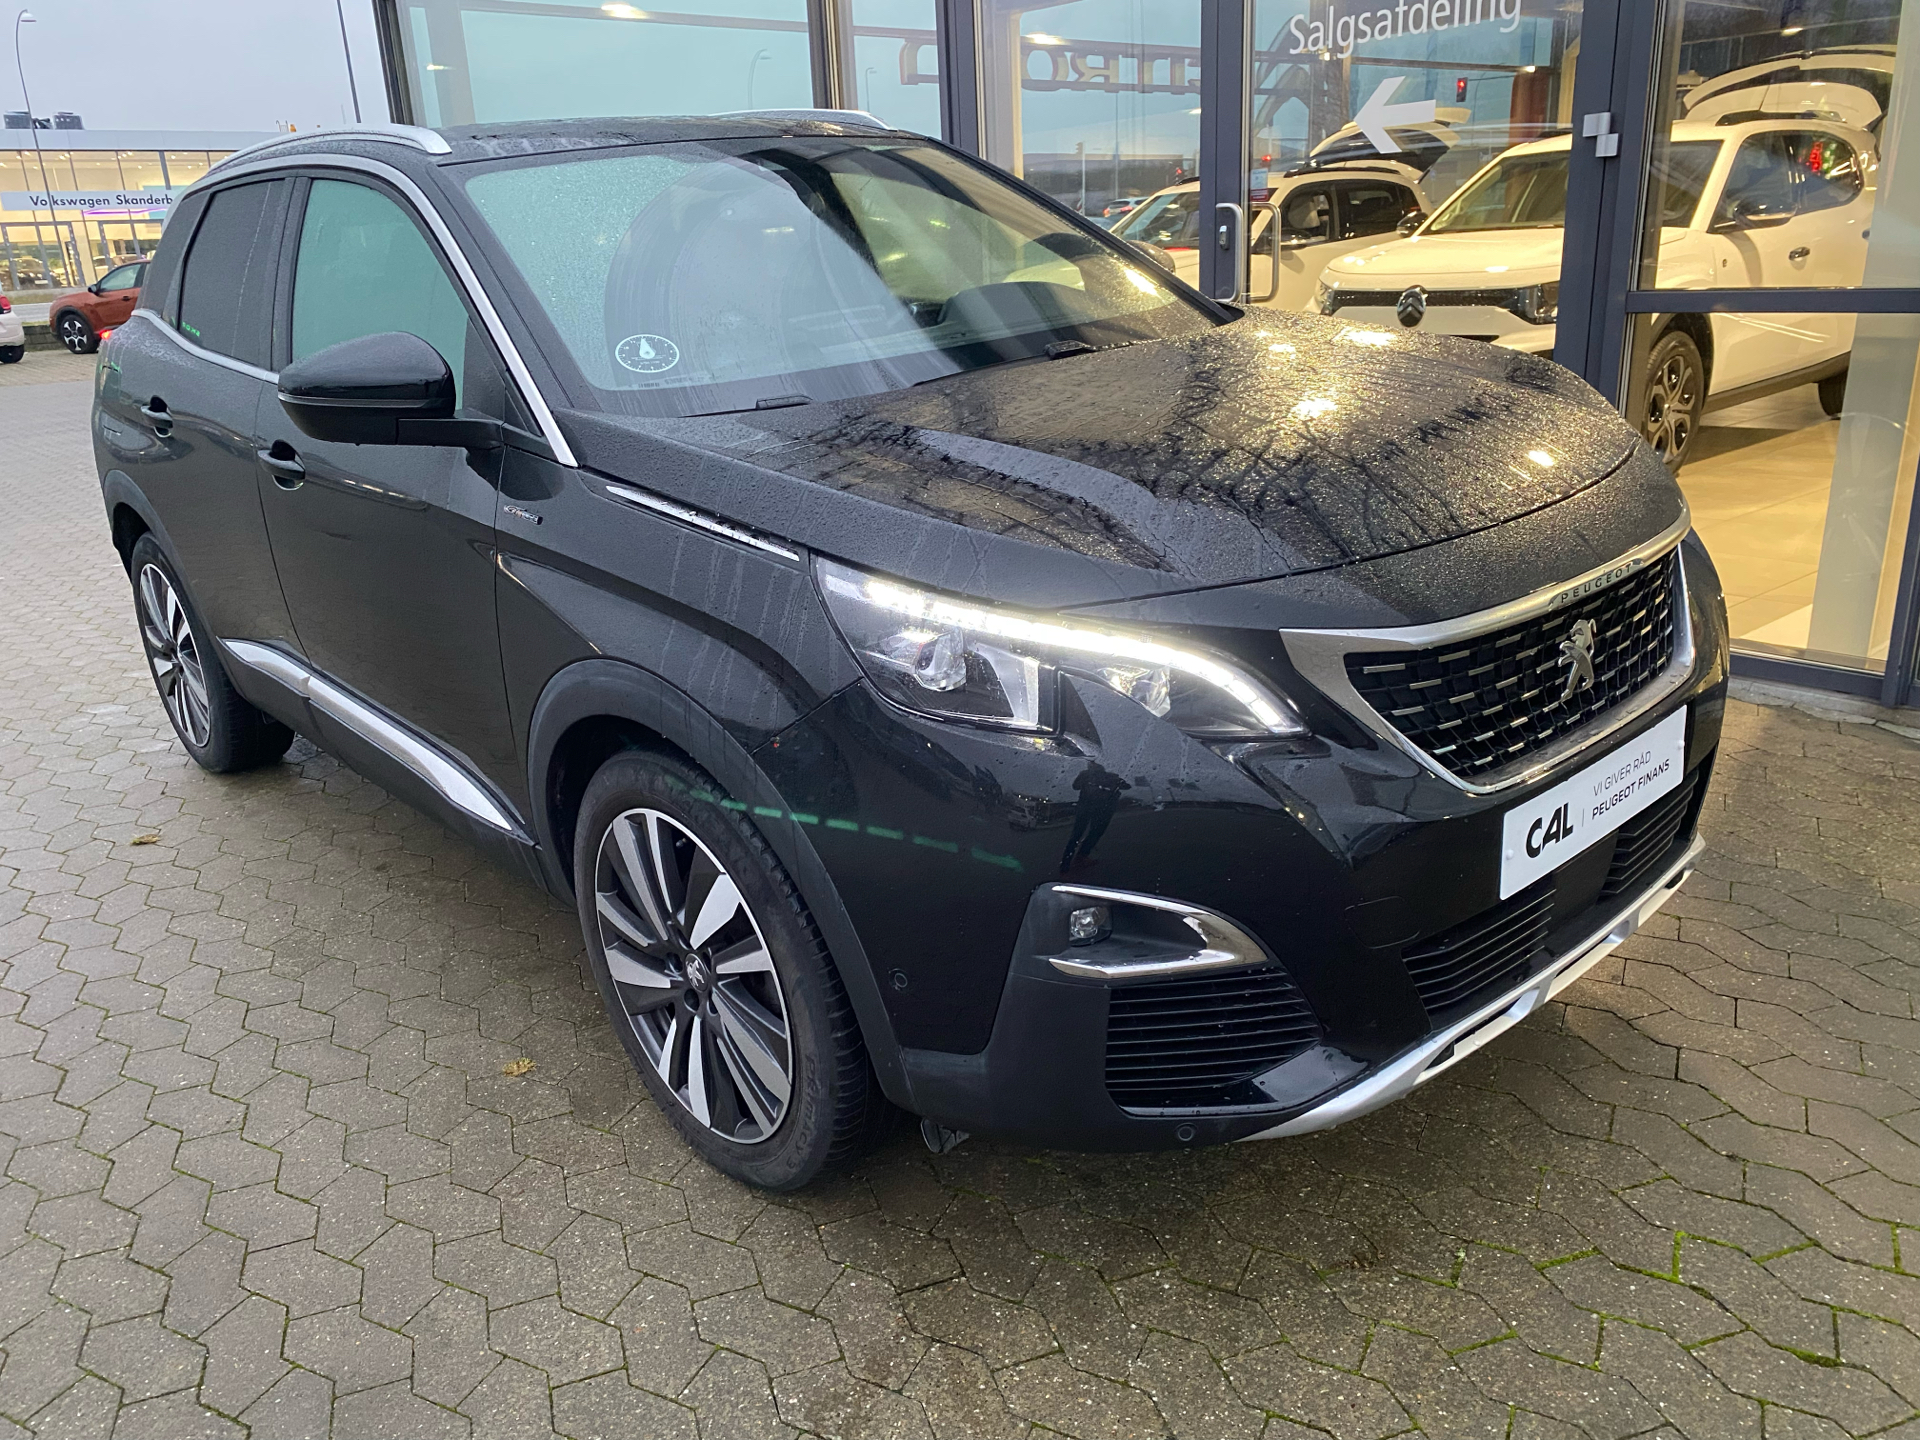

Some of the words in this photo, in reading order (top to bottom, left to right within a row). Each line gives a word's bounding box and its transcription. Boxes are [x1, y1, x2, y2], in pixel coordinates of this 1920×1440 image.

[1289, 0, 1521, 58] Salgsafdeling
[29, 194, 110, 208] Vokswagen
[1561, 564, 1632, 603] PEUGEOT
[1592, 781, 1637, 820] PEUGEOT
[1637, 759, 1670, 790] FINANS
[1593, 781, 1603, 797] VI
[1604, 763, 1632, 789] GIVER
[1633, 751, 1652, 772] RÅD
[1526, 803, 1574, 858] CAL
